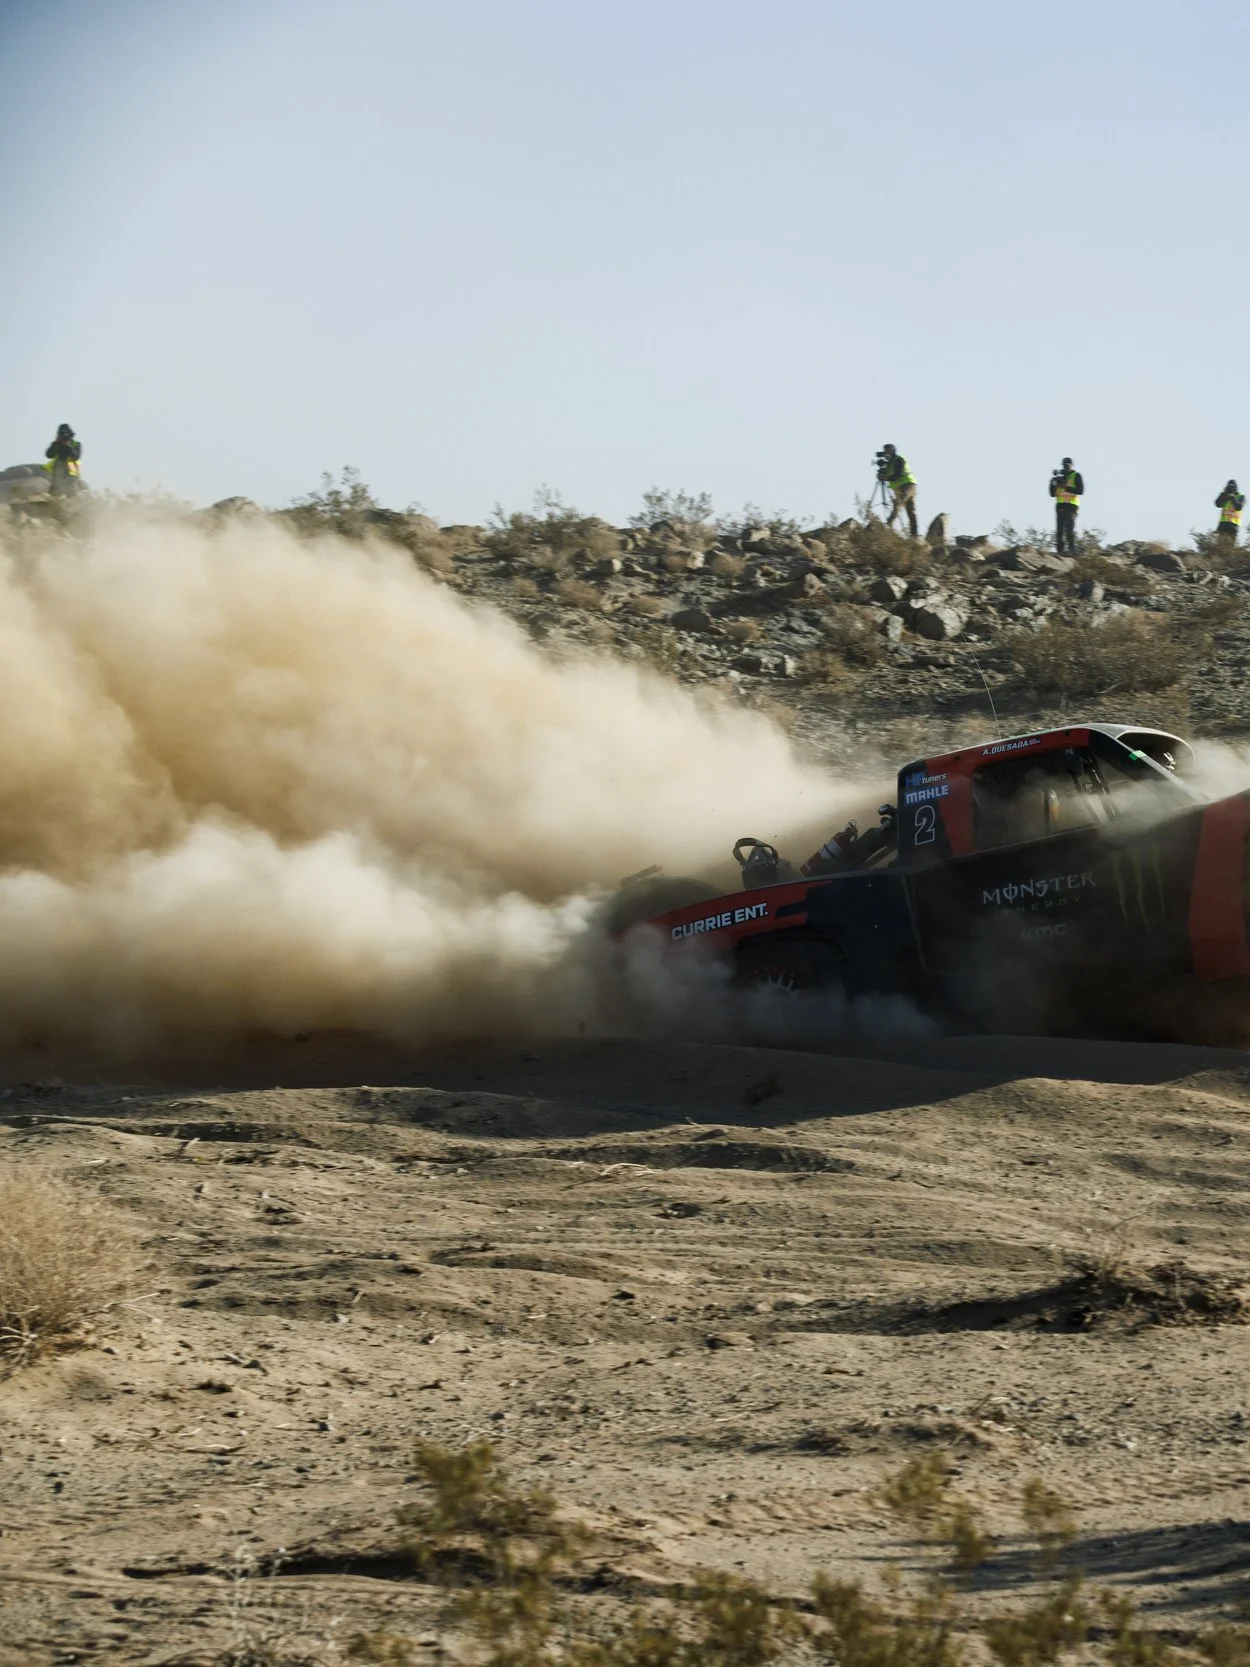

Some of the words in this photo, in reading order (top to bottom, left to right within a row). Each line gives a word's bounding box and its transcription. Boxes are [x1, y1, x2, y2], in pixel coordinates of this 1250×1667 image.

[905, 785, 949, 804] MAHLE
[914, 804, 936, 846] 2
[981, 871, 1097, 905] MONSTER
[1014, 894, 1081, 912] NERGY
[671, 911, 731, 940] CURRIE
[734, 902, 769, 924] ENT.
